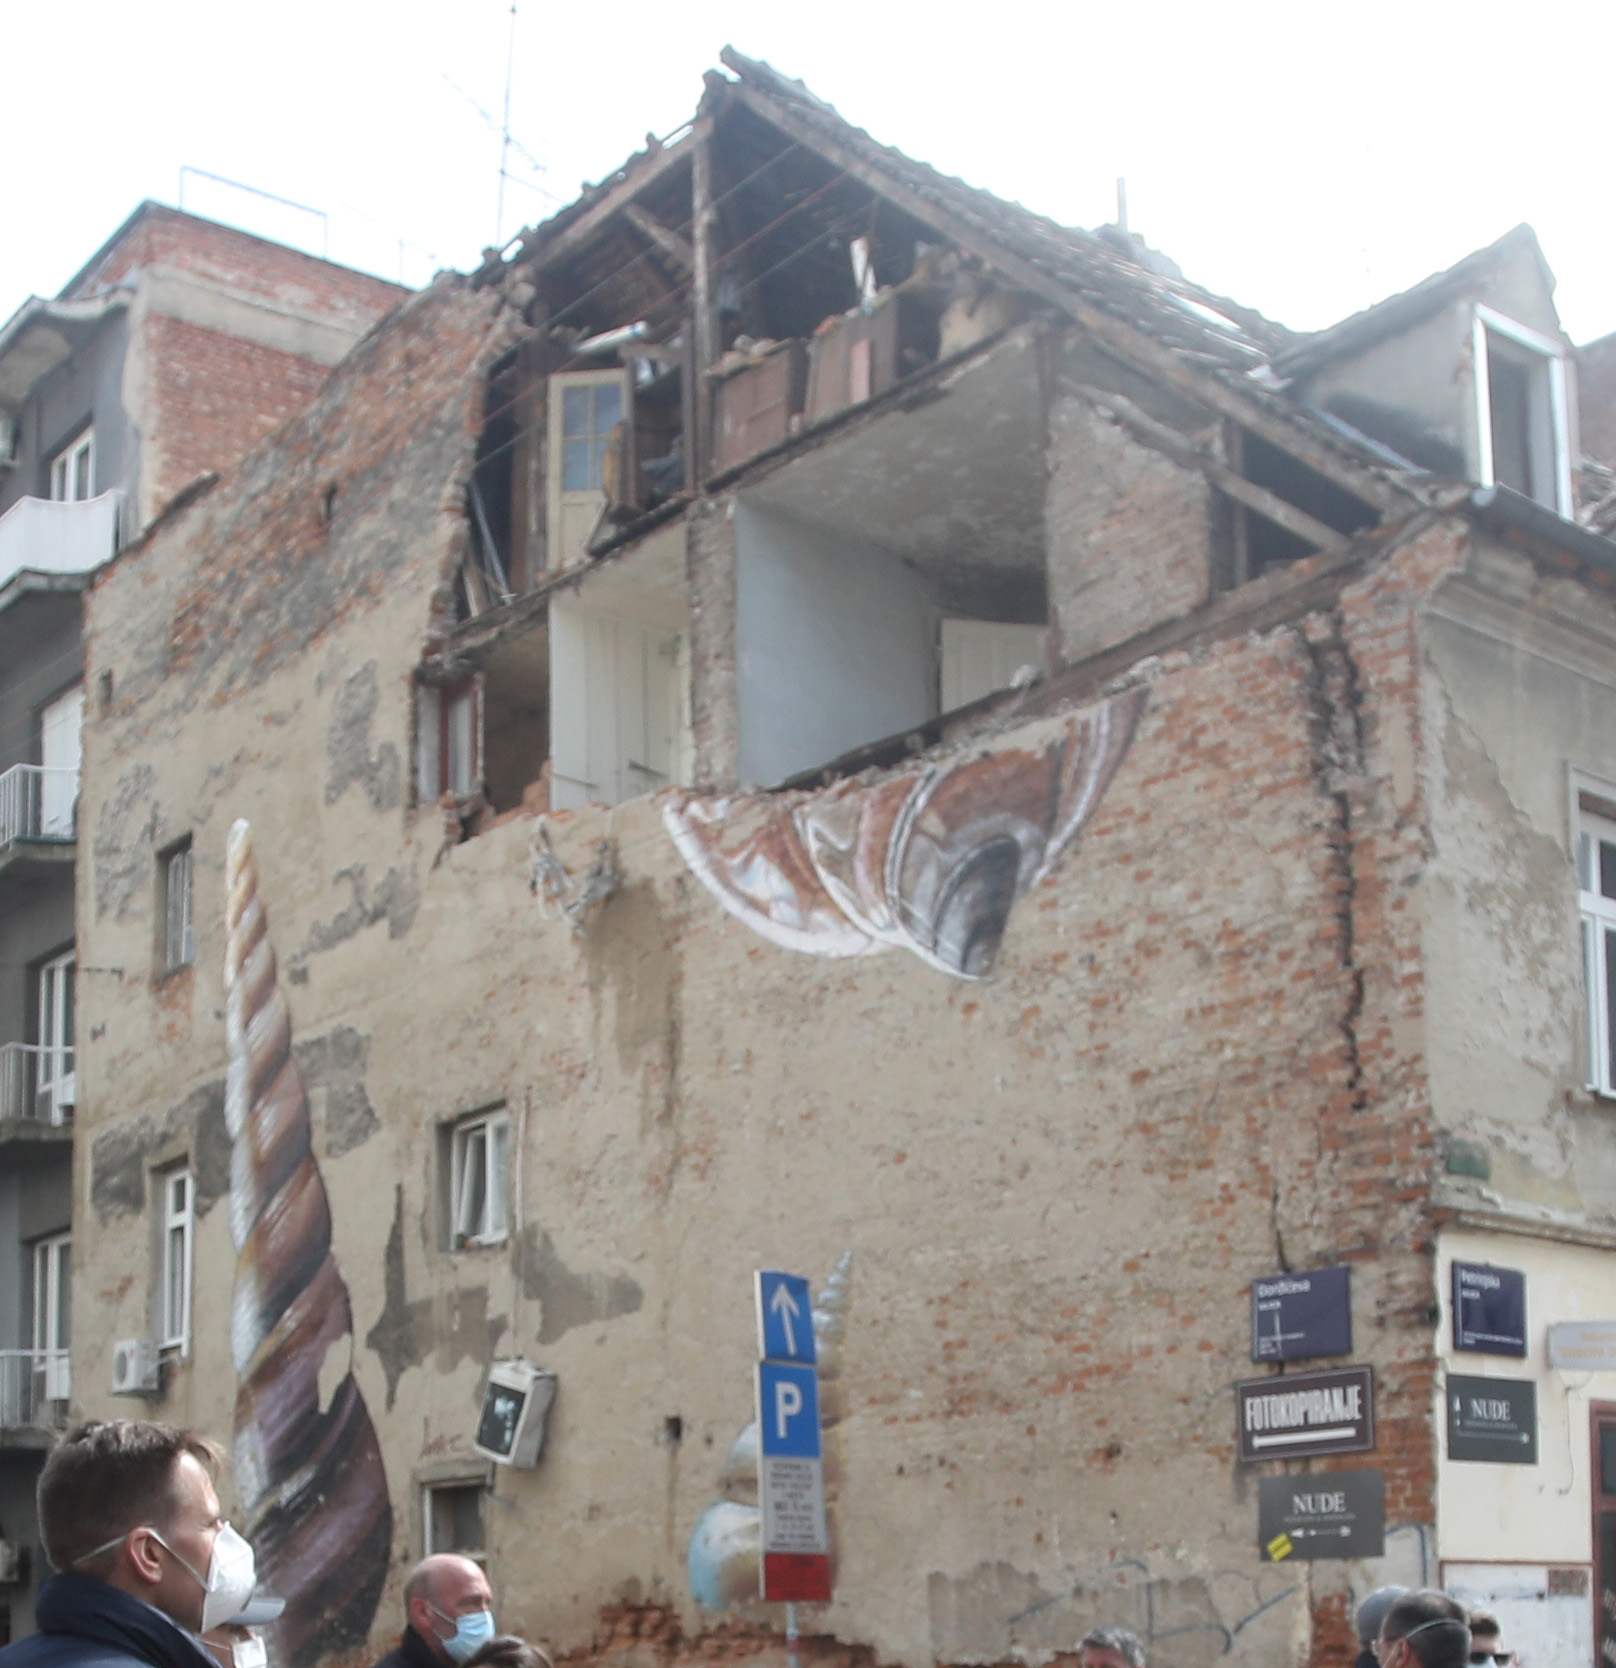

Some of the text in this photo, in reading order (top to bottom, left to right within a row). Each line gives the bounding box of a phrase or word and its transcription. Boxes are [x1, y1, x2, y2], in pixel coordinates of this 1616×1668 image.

[775, 1381, 802, 1439] P
[1245, 1385, 1362, 1432] FOTOKOPIRANJE
[1471, 1398, 1511, 1421] NUDE
[1293, 1492, 1346, 1514] NUDE
